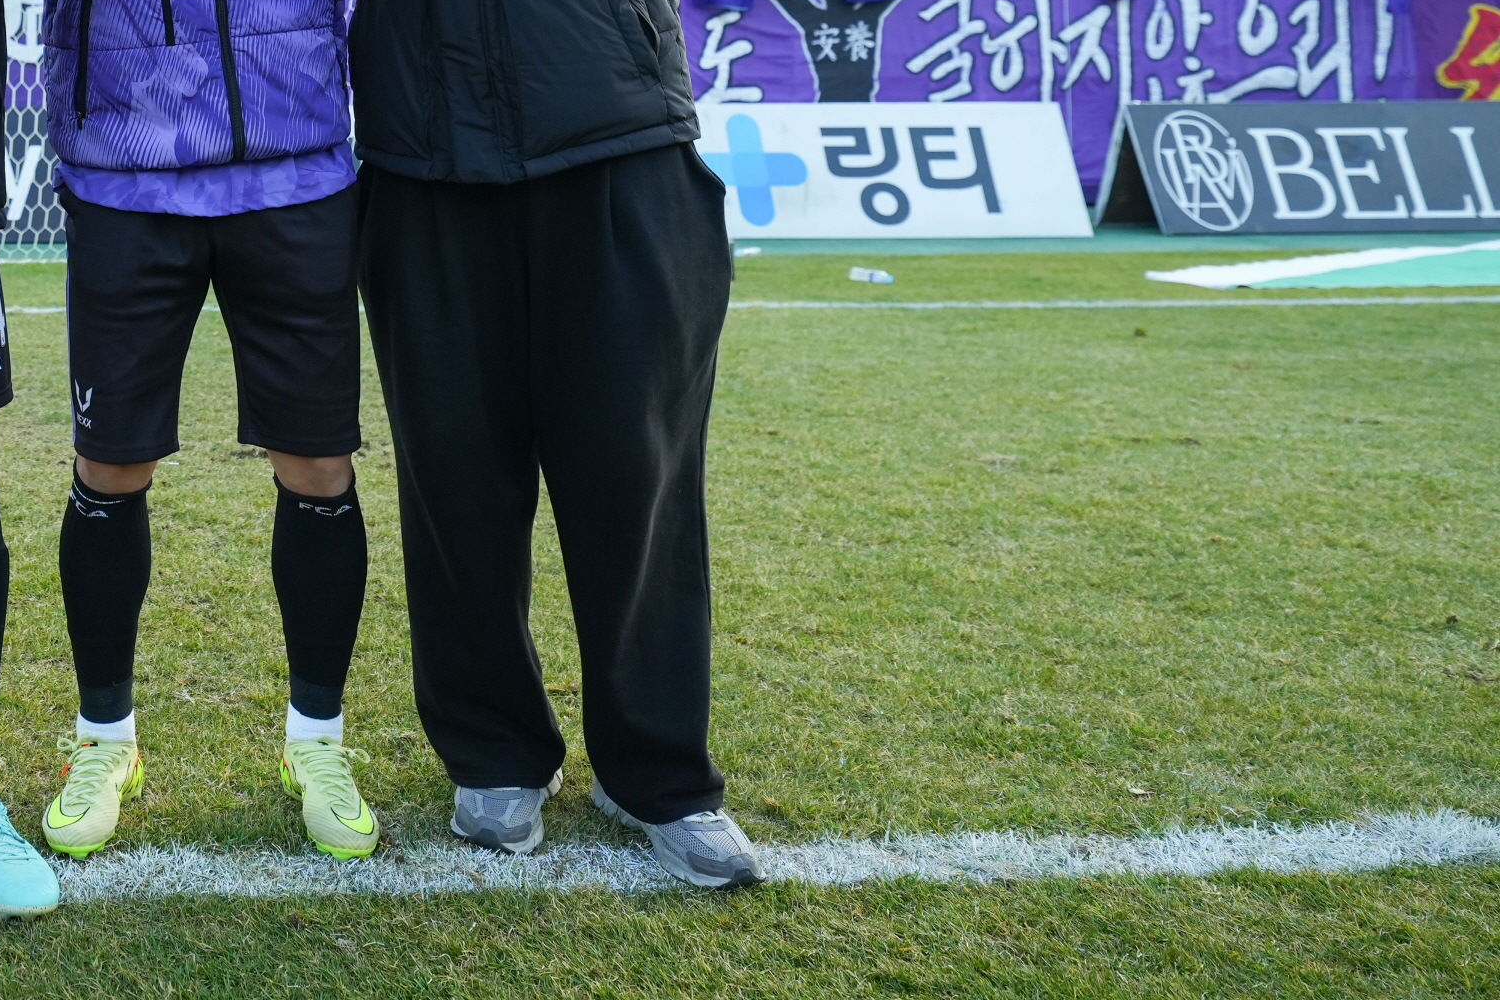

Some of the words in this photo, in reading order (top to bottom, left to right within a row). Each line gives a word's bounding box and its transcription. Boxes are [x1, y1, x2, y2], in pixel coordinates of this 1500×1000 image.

[820, 127, 1003, 226] 링티
[1246, 126, 1500, 220] BELL
[298, 501, 353, 517] FCA
